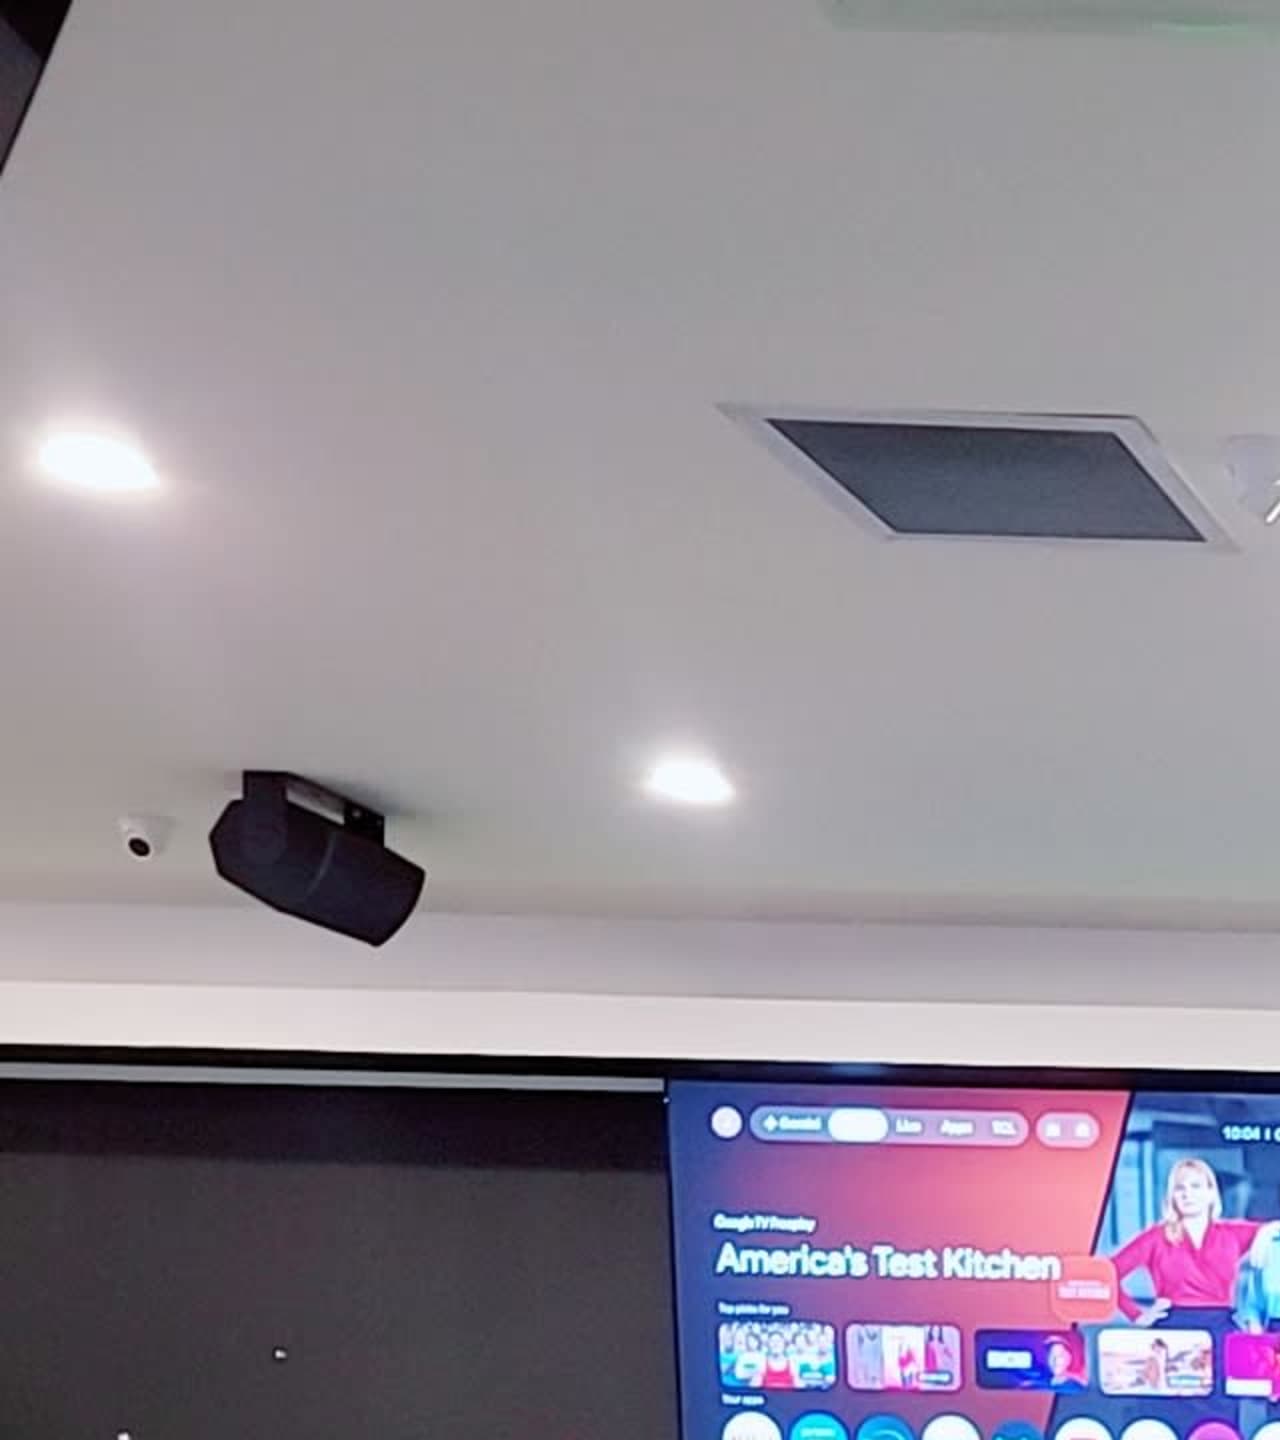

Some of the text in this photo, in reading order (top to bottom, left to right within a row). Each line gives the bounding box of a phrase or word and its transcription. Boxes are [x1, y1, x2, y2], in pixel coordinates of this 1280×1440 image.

[716, 1242, 1062, 1281] America's Test Kitchen
